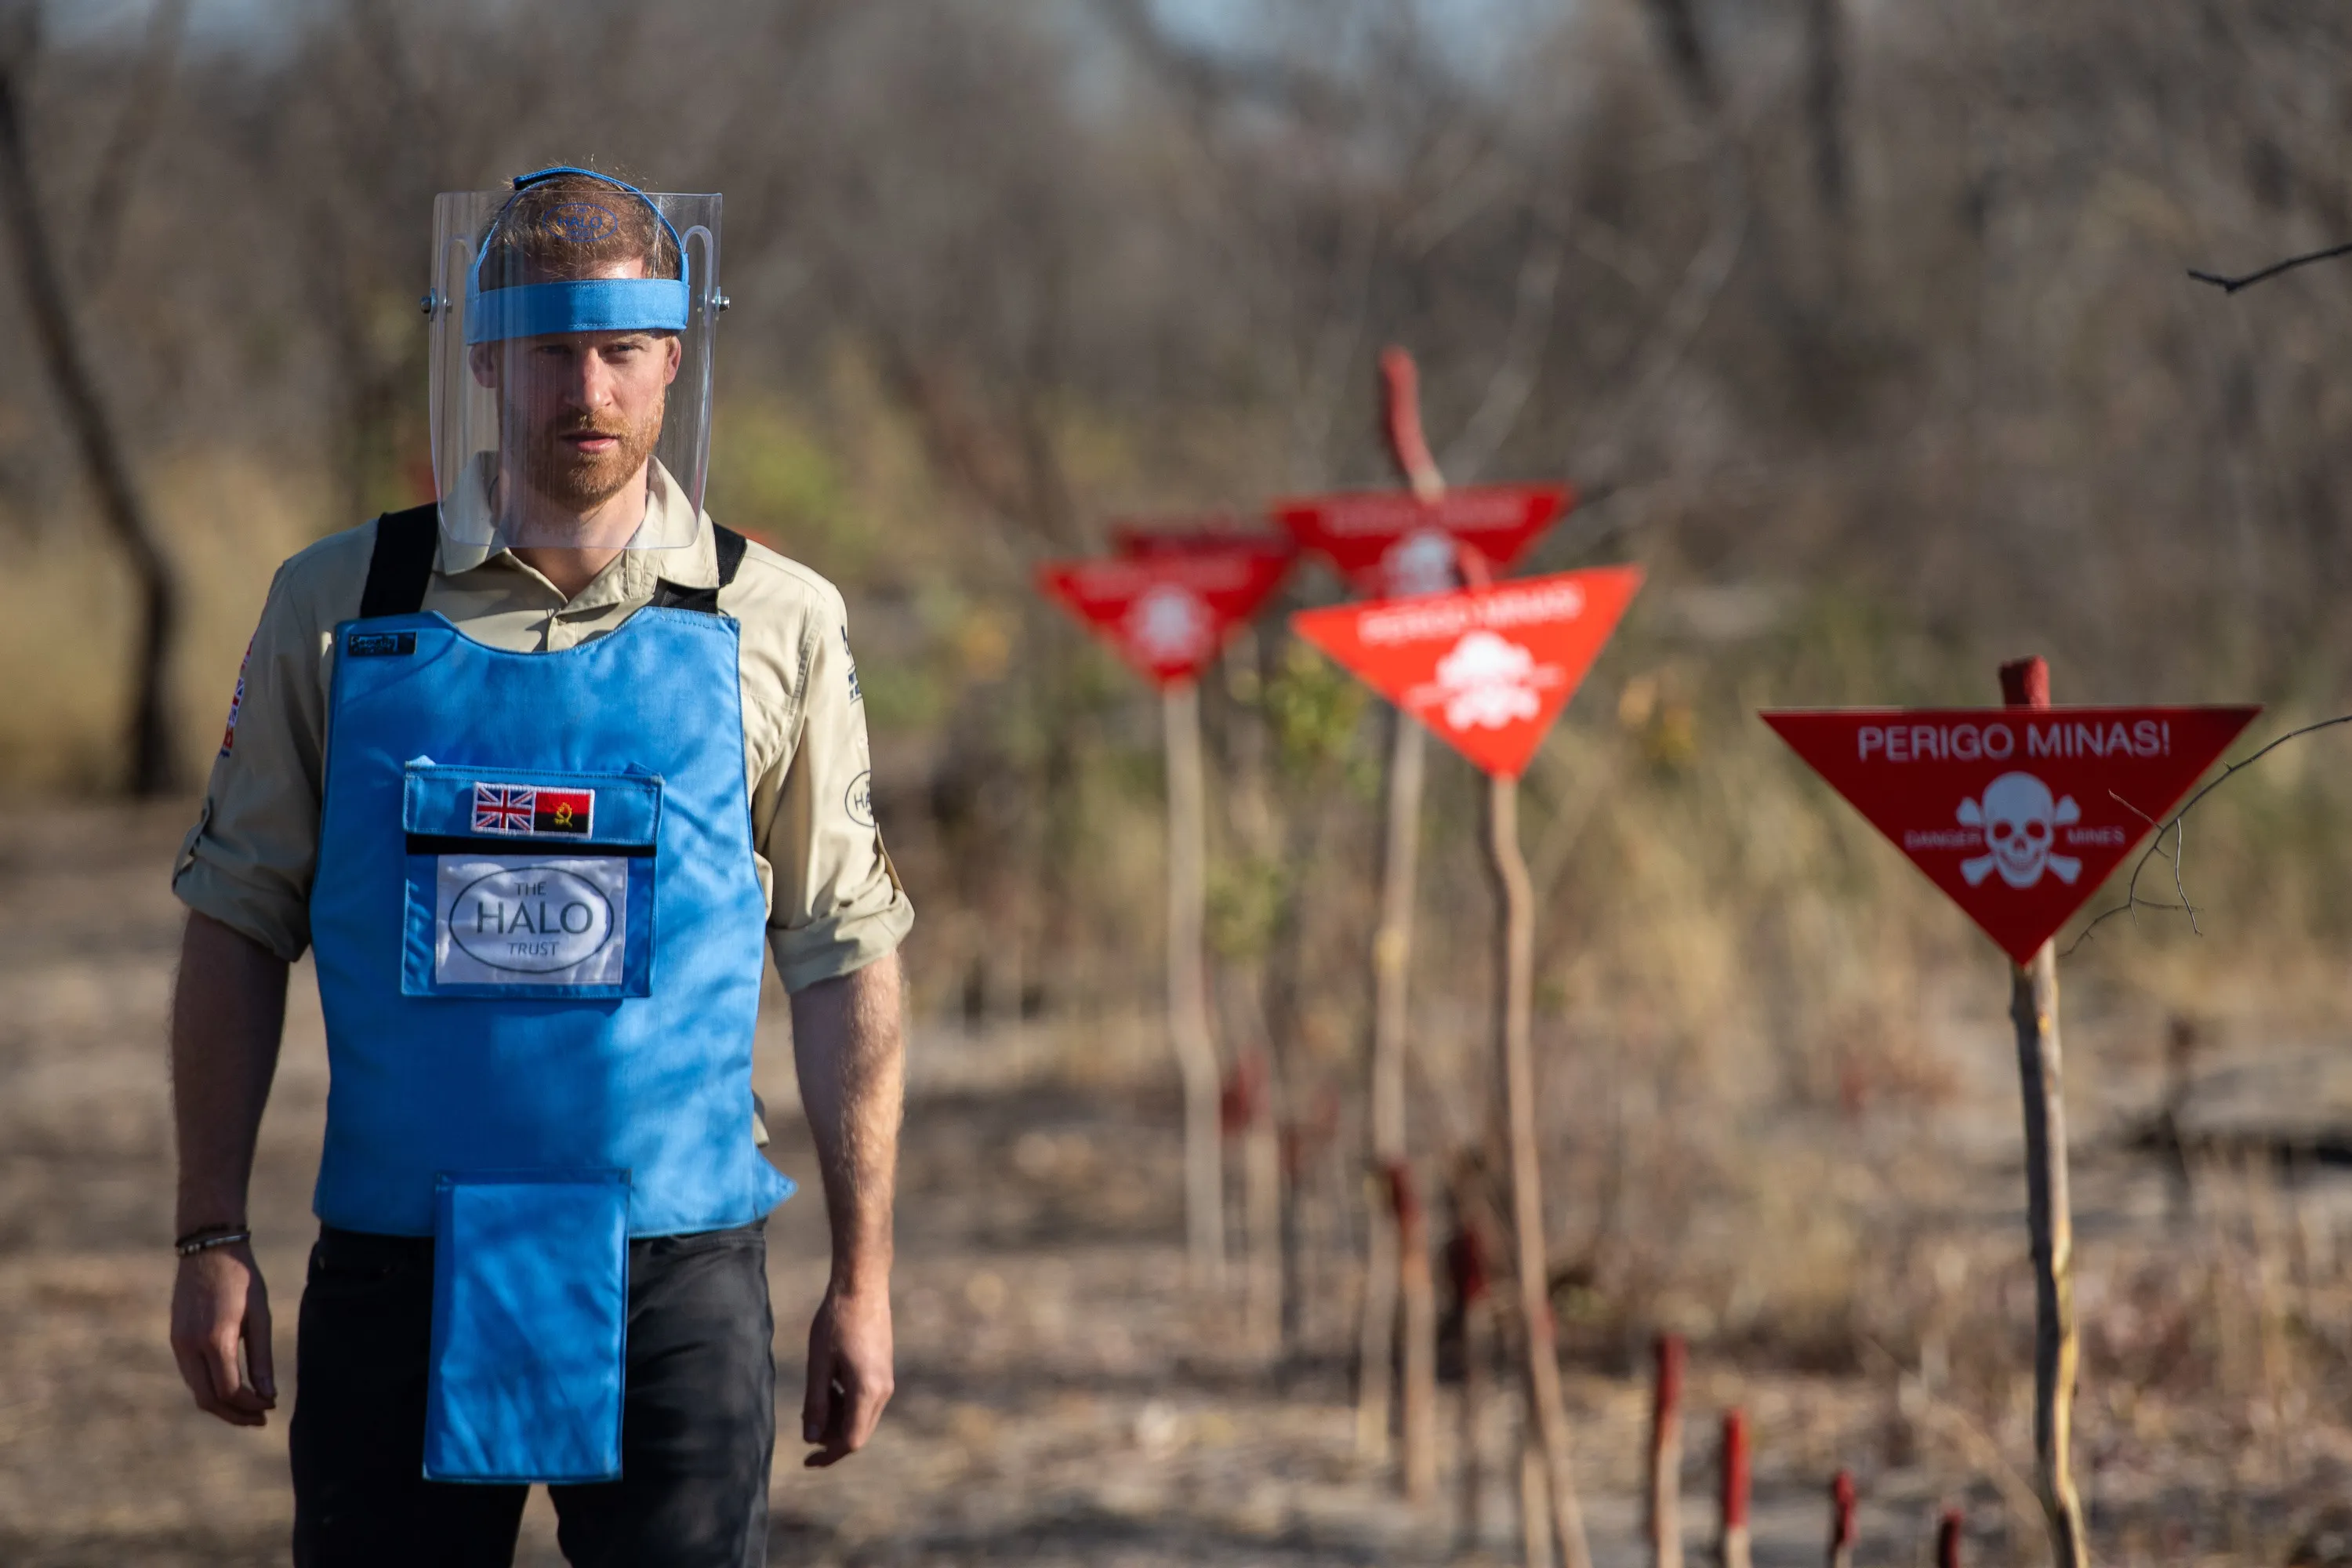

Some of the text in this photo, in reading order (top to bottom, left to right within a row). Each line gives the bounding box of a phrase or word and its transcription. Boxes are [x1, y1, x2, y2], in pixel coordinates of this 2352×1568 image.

[557, 216, 602, 229] HALO
[1858, 719, 2171, 761] PERIGO MINAS!
[2067, 826, 2125, 846] MINES
[514, 881, 546, 896] THE
[477, 901, 593, 934] HALO
[508, 942, 560, 956] TRUST
